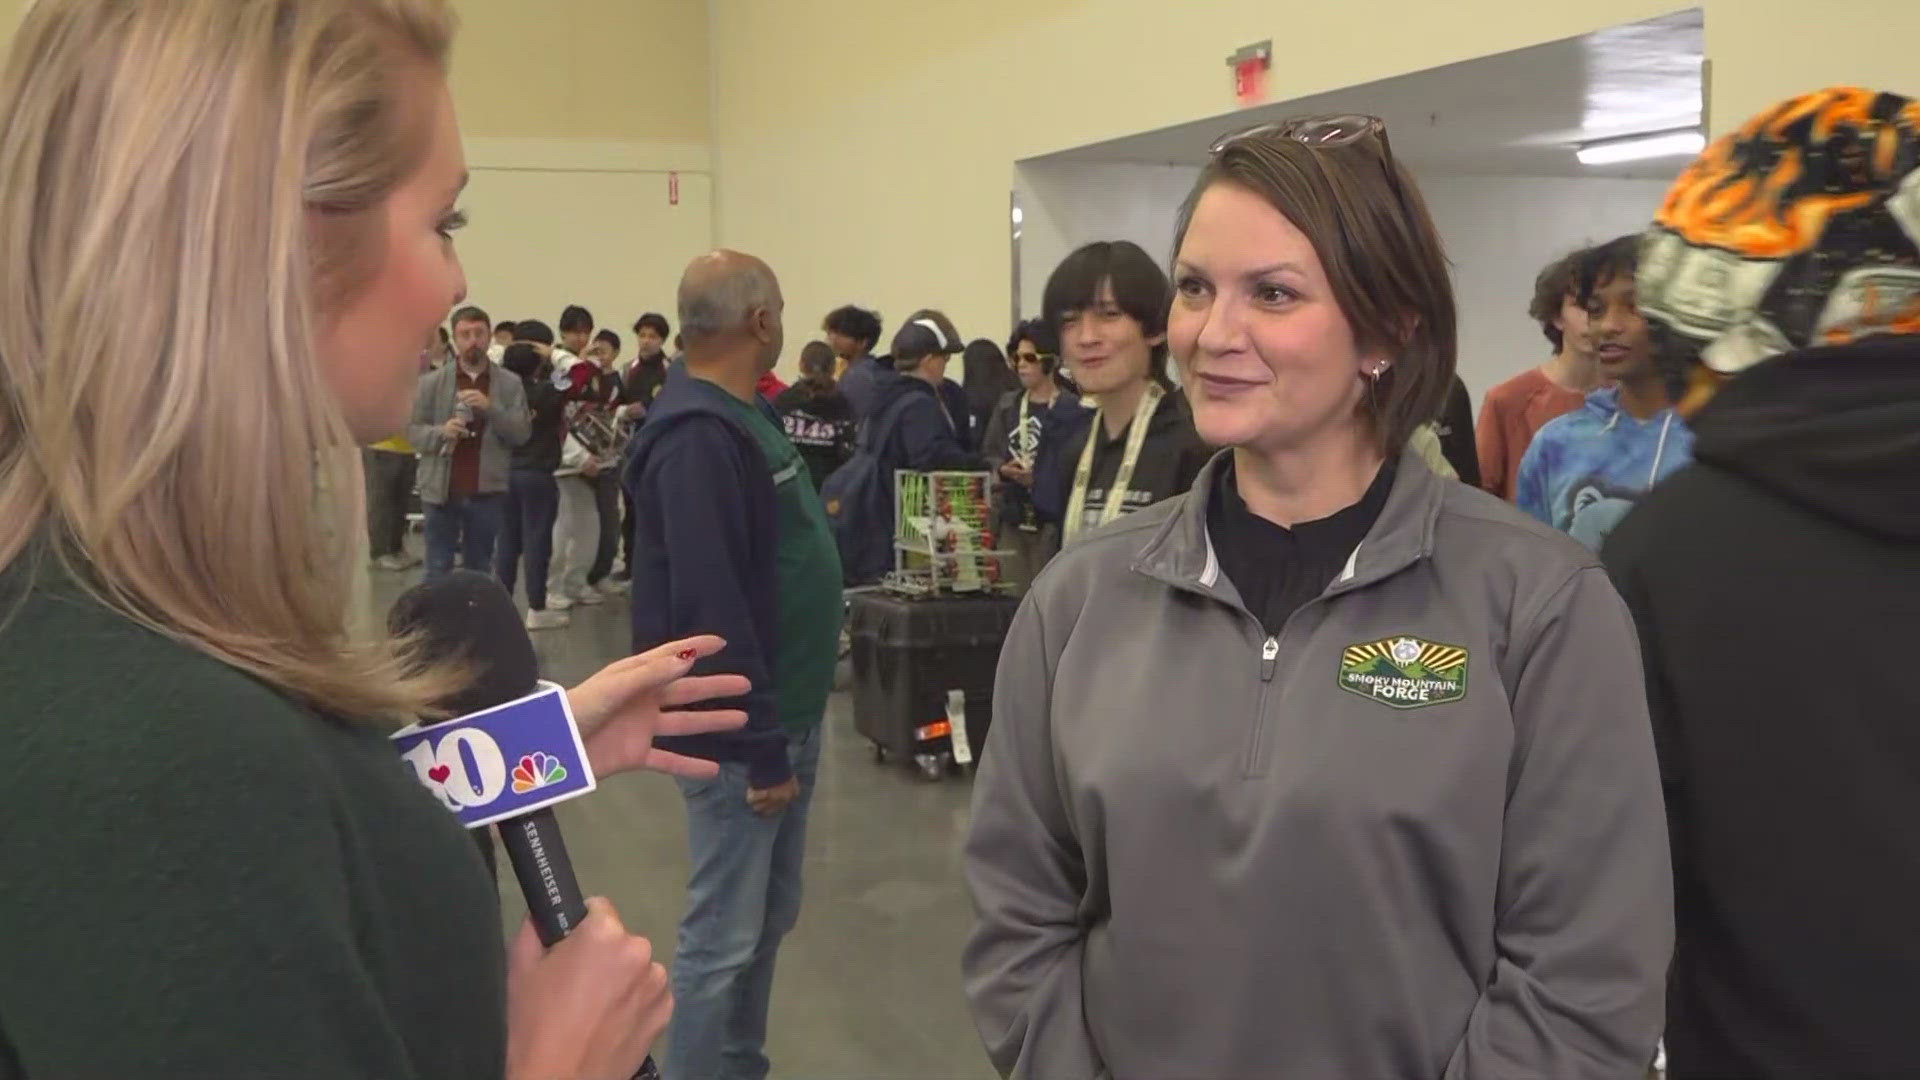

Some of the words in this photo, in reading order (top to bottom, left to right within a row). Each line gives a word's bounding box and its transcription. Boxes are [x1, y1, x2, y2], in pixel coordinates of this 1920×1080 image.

[1348, 673, 1390, 686] SMOKY
[1392, 677, 1457, 691] MOUNTAIN
[1372, 685, 1429, 700] FORGE
[401, 727, 506, 812] 10
[523, 821, 562, 906] SENNHEISER
